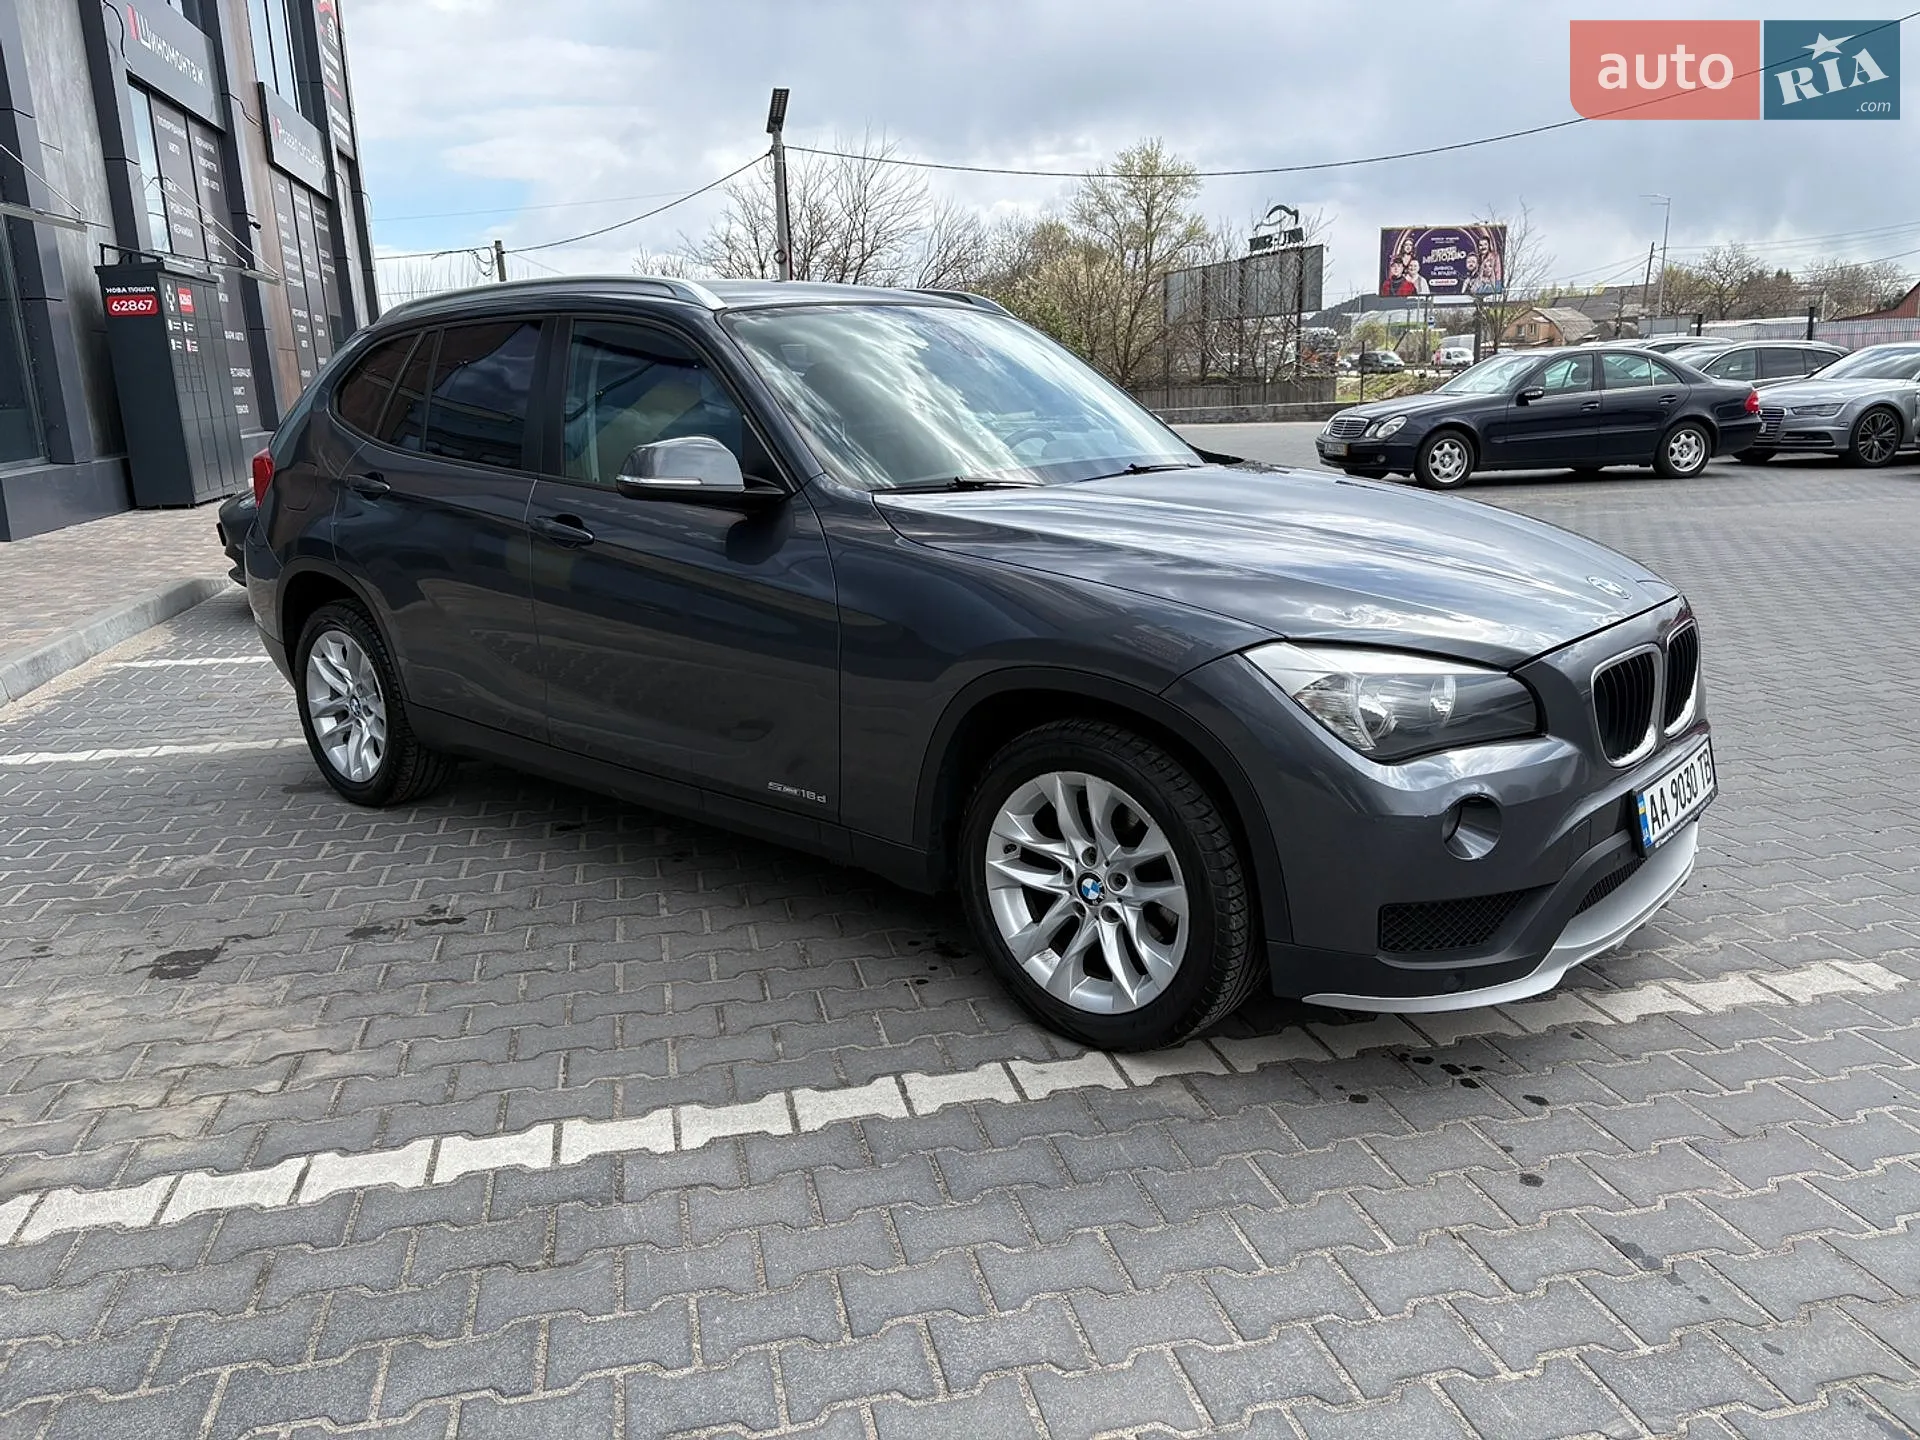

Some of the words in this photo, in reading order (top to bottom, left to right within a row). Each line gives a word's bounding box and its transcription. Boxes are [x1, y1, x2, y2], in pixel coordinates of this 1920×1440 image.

[111, 300, 153, 312] 62867
[1649, 787, 1671, 836] AA
[1670, 762, 1699, 817] 9030
[1697, 748, 1712, 790] TB
